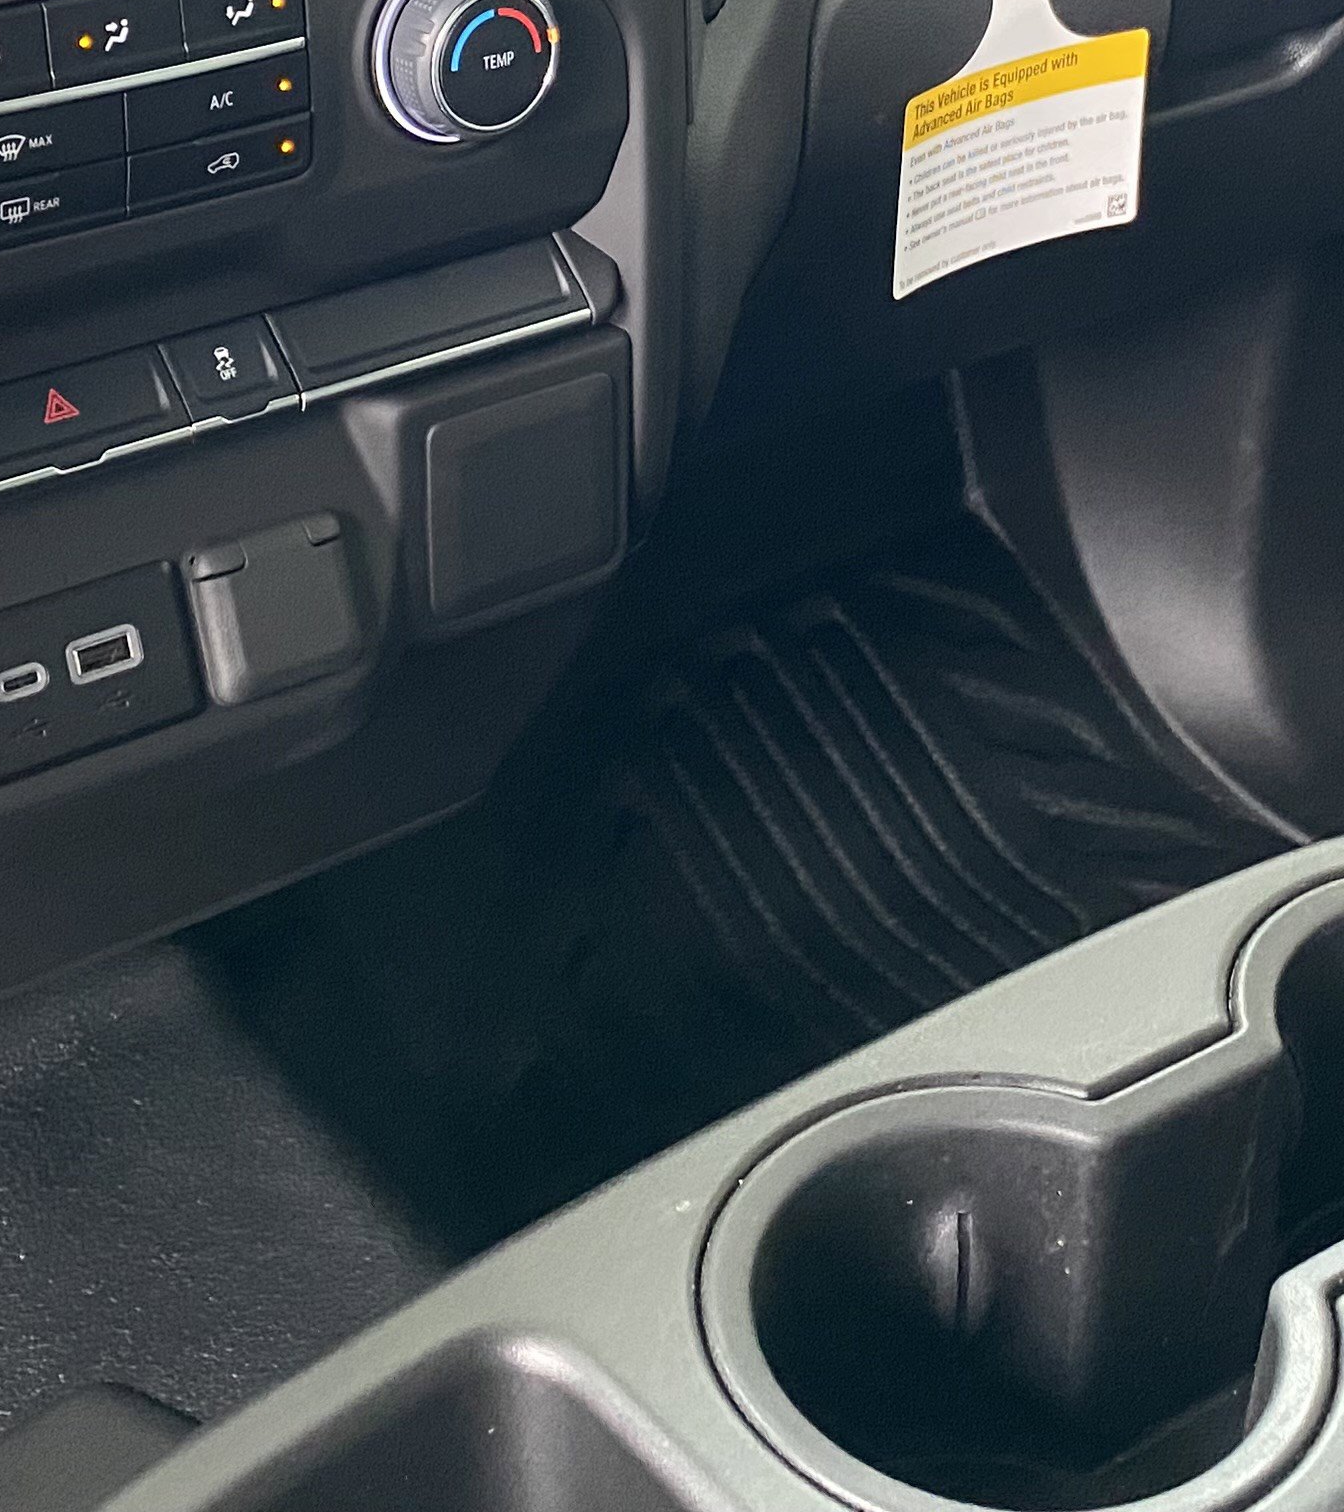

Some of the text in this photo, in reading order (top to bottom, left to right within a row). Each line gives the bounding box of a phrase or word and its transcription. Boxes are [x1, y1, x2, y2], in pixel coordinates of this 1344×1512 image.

[482, 51, 516, 71] TEMP
[914, 51, 1078, 121] This Vehicle is Equipped with
[209, 90, 234, 111] A/C
[912, 89, 1014, 141] Advanced Air Bags
[28, 133, 54, 150] MAX
[32, 196, 61, 213] REAR
[219, 367, 237, 381] OFF
